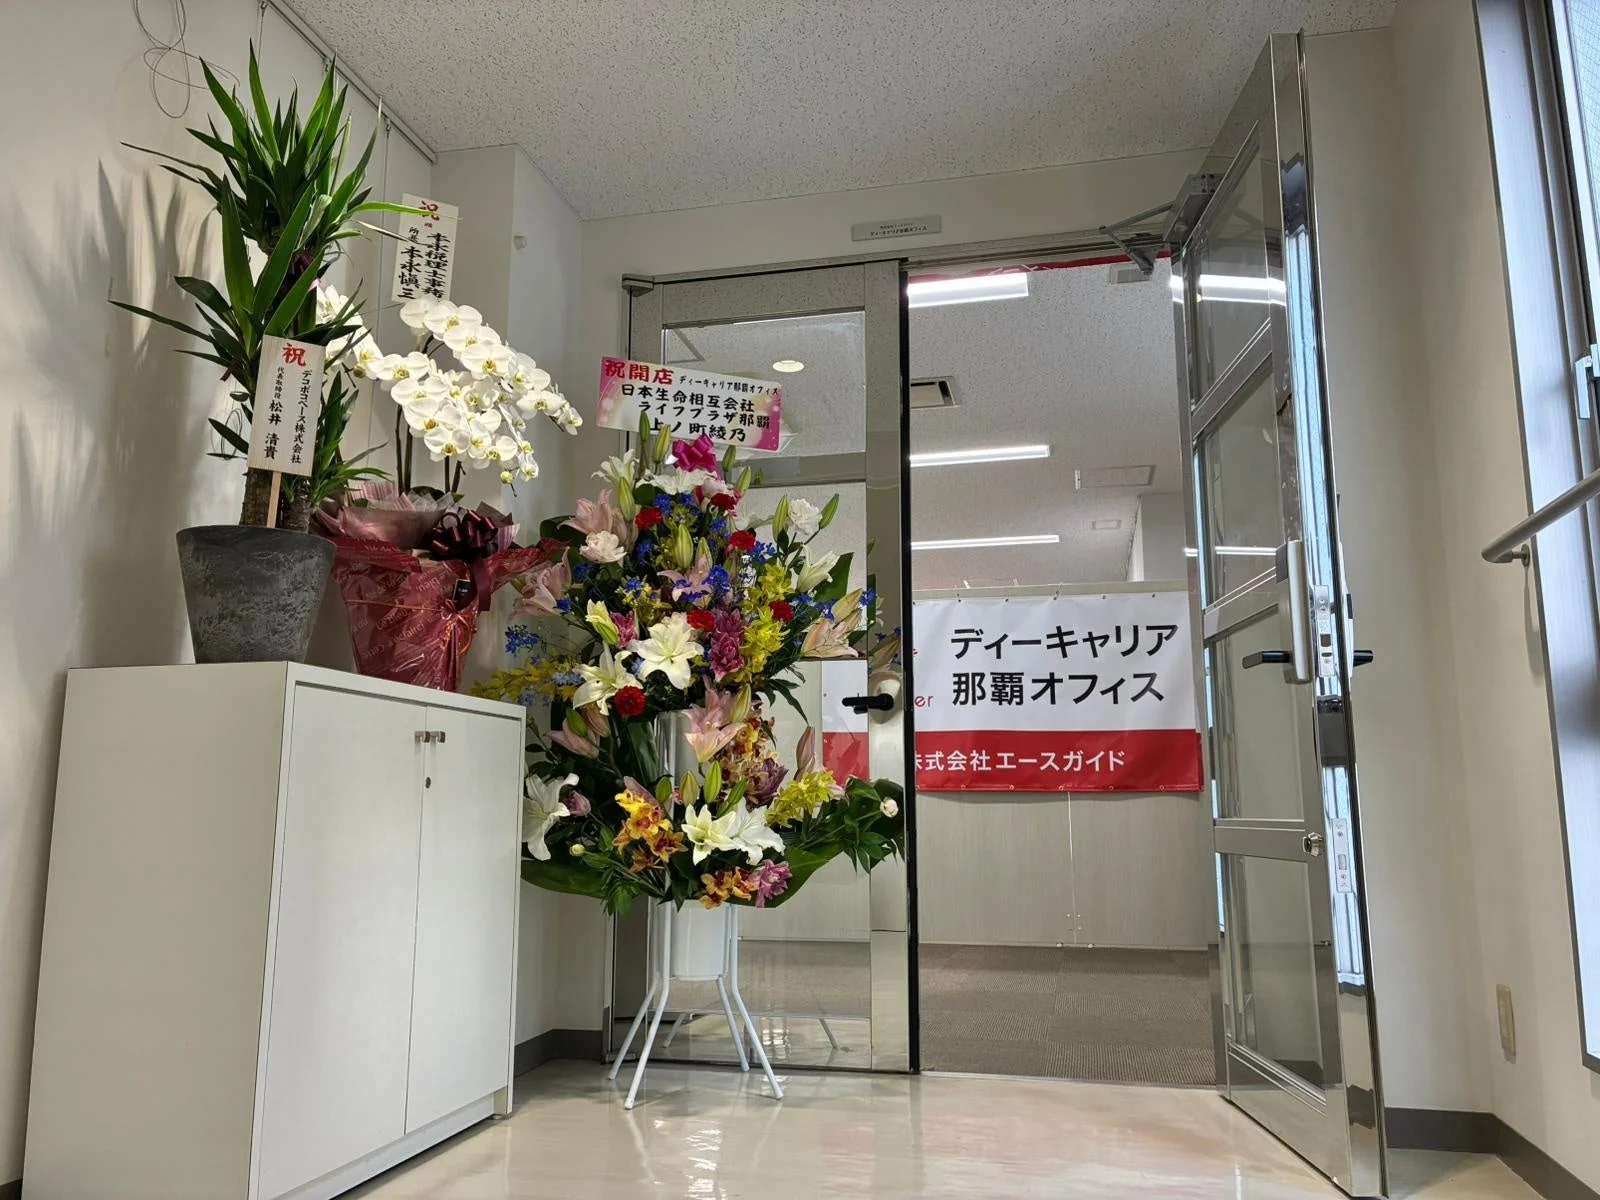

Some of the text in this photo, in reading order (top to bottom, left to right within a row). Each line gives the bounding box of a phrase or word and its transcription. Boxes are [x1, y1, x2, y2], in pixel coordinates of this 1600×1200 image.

[421, 232, 451, 300] 本永税理士事務
[282, 342, 307, 367] 祝
[604, 359, 675, 386] 祝開店
[679, 374, 779, 396] ディーキャリア那覇オフィス
[621, 383, 755, 412] 日本生命相互会社
[268, 399, 284, 426] 松井
[291, 369, 313, 464] デコボコベース株式会社
[263, 432, 280, 460] 清貴
[950, 624, 1179, 661] ディーキャリア
[952, 671, 1165, 707] 那覇オフィス
